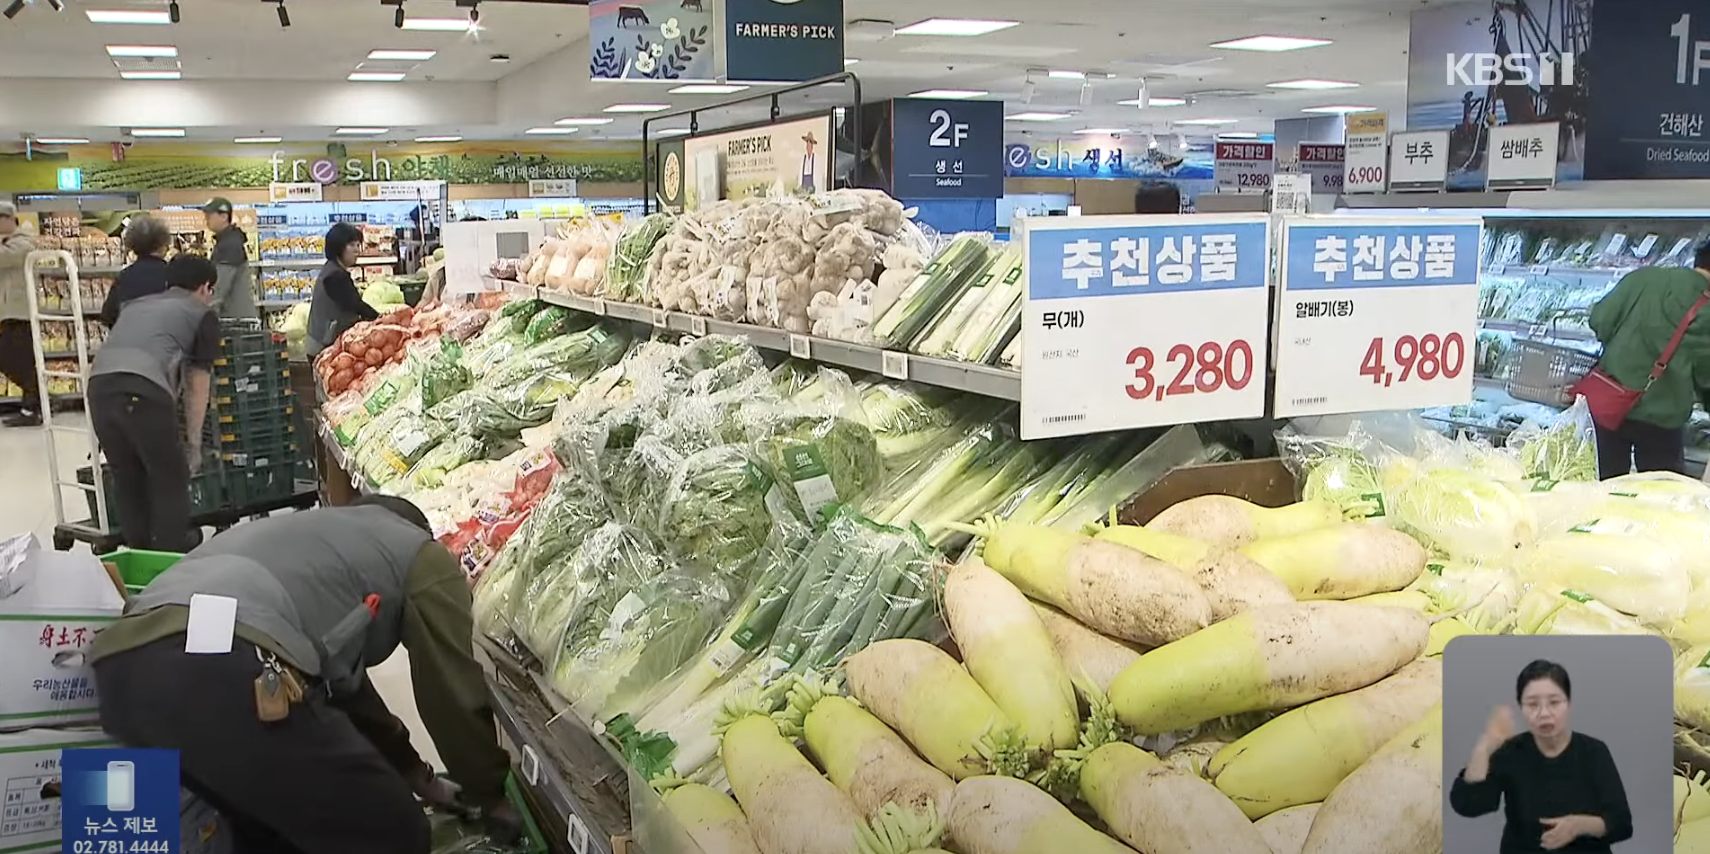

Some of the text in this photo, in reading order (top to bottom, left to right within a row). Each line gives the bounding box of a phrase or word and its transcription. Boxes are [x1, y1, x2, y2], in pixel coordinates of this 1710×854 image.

[735, 23, 836, 39] FARMER'S PICK
[929, 109, 969, 148] 2F
[728, 135, 772, 156] FARMER'S PICK
[1008, 139, 1073, 171] esh
[1222, 145, 1266, 158] 가격할인
[1405, 142, 1434, 164] 부추
[1501, 138, 1543, 159] 쌈배추
[1646, 147, 1709, 163] Dried Seafood
[269, 149, 391, 181] fresh
[544, 165, 578, 179] 신선한
[581, 164, 593, 178] 맛
[1348, 166, 1383, 184] 6,900
[936, 177, 962, 187] Seafood
[1237, 173, 1270, 187] 12,980
[1323, 174, 1343, 187] 9,98
[1062, 234, 1237, 289] 추천상품
[1313, 235, 1456, 282] 추천상품
[1295, 300, 1354, 319] 알배기(봉)
[1042, 310, 1085, 330] 무(개)
[1360, 332, 1465, 387] 4,980
[1125, 339, 1253, 401] 3,280
